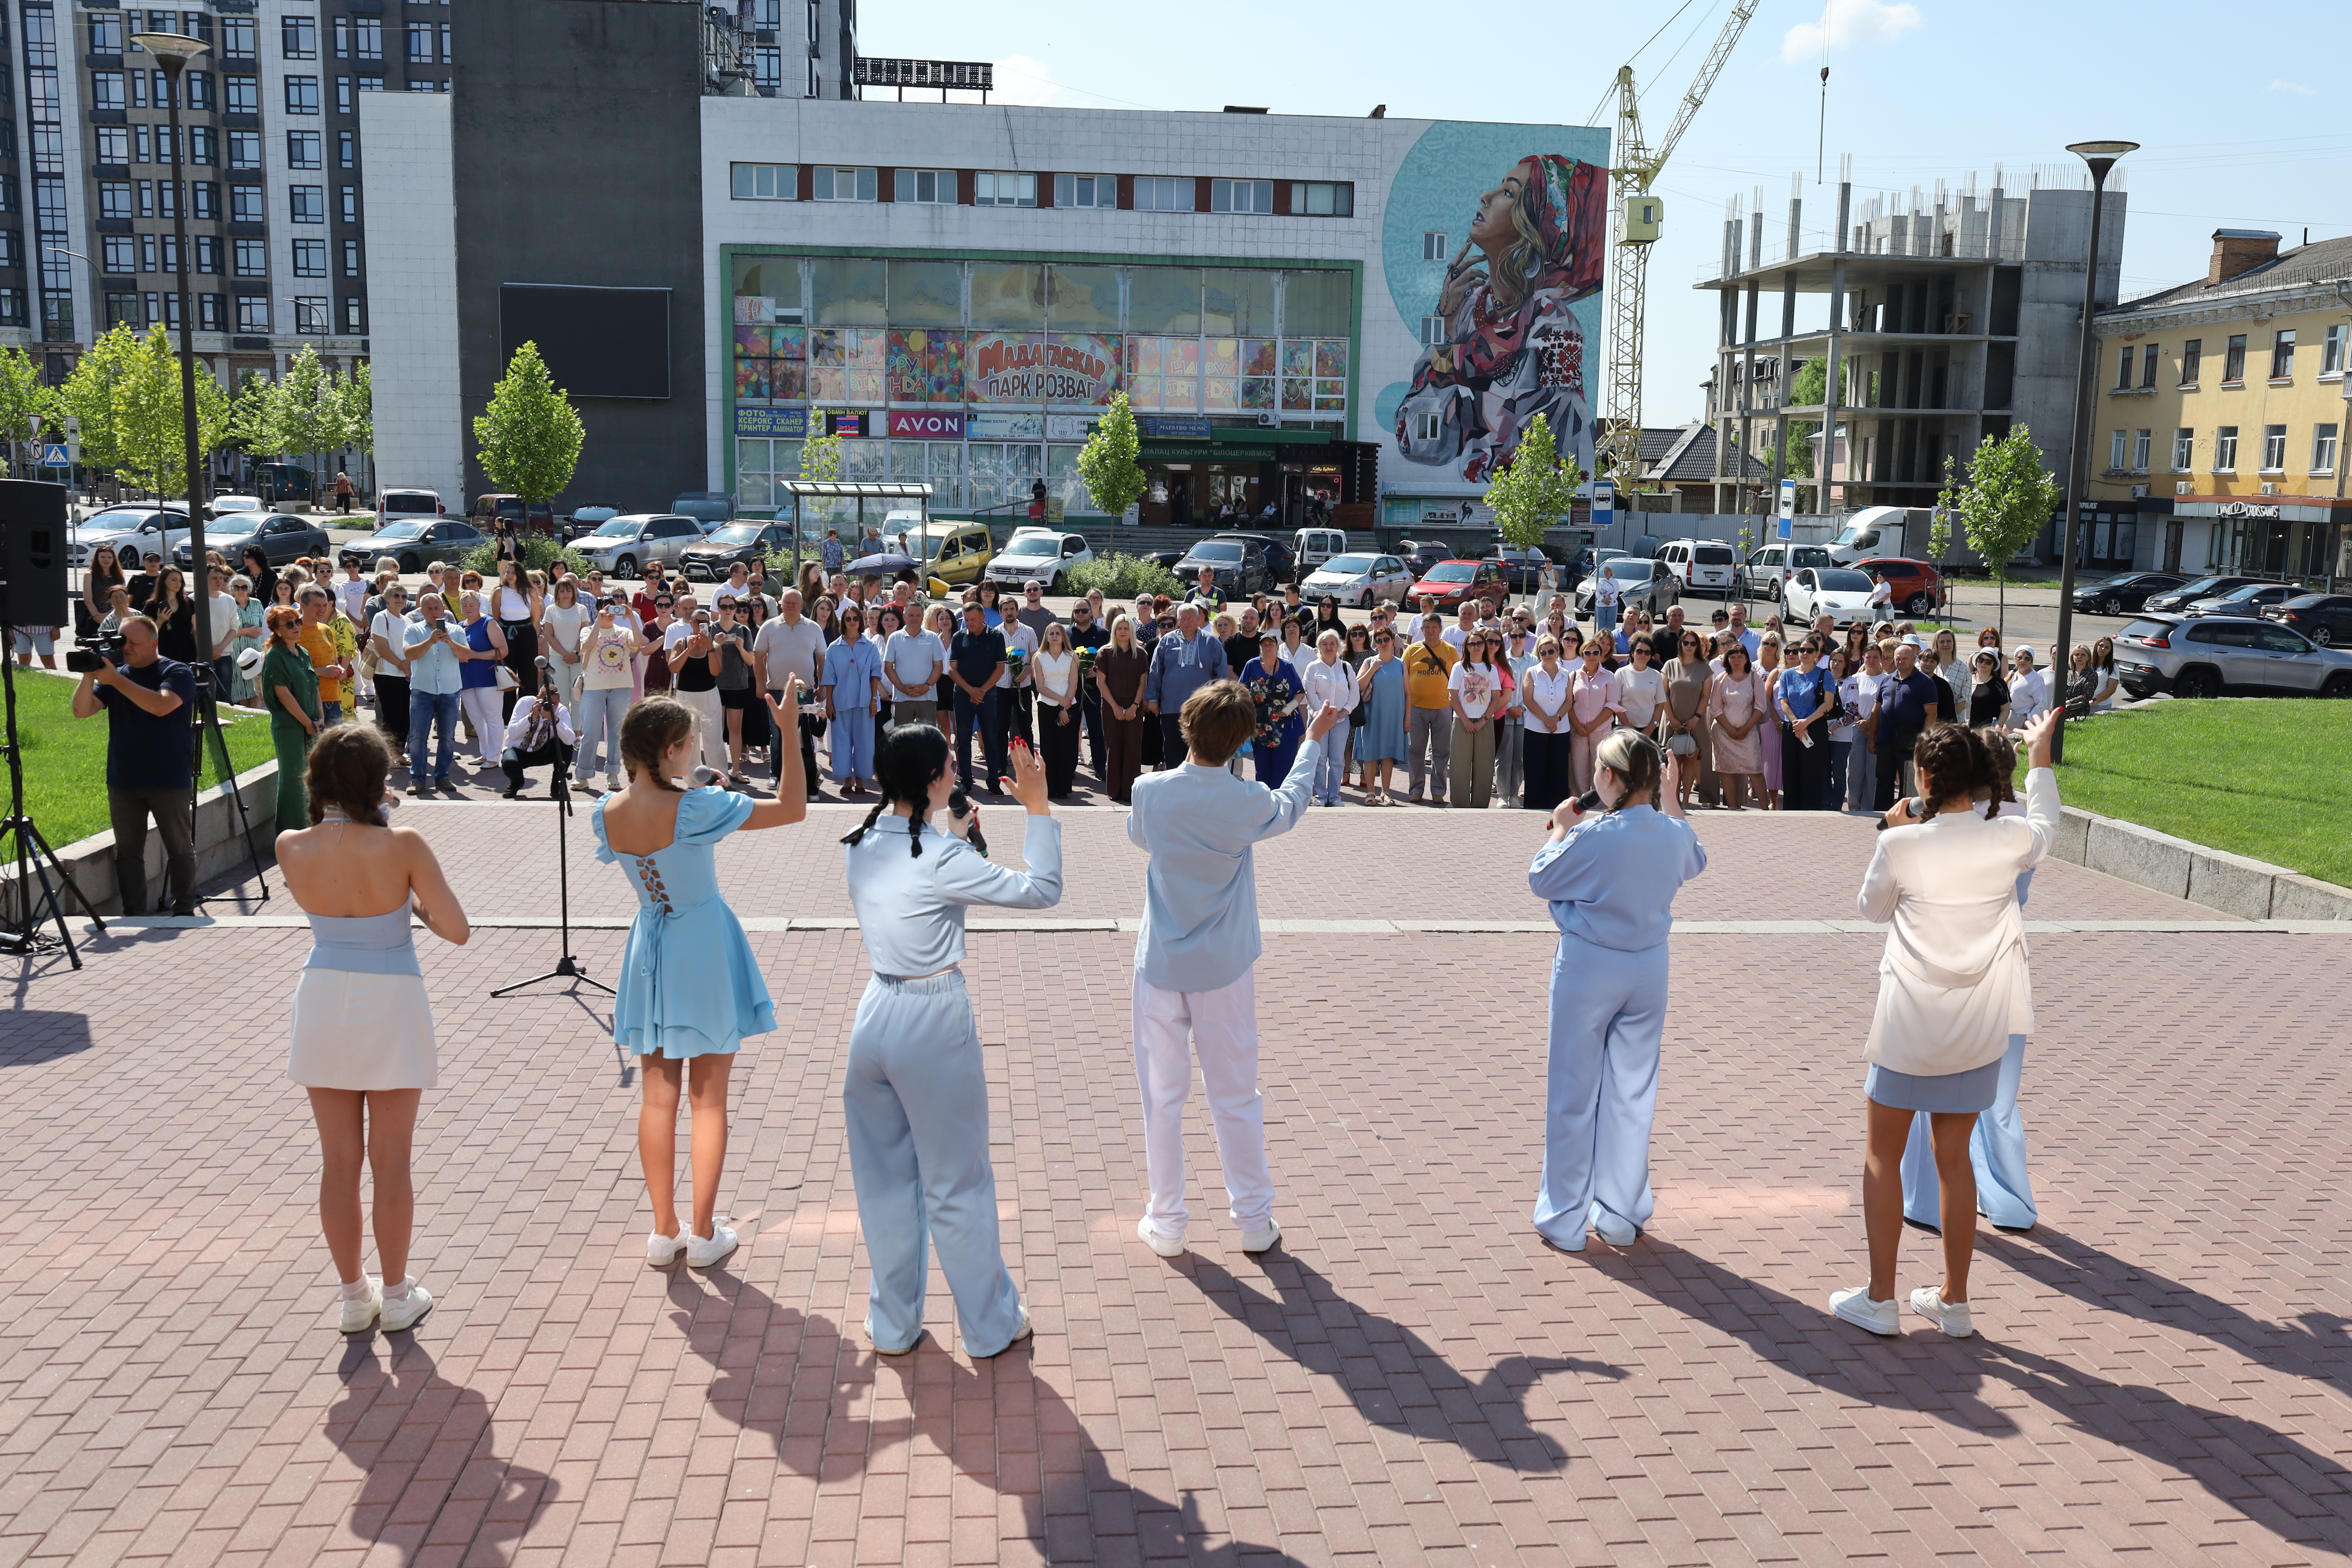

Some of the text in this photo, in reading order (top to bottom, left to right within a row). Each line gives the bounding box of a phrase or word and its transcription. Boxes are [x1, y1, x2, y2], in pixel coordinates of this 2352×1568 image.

[1171, 361, 1227, 378] HAPY
[988, 372, 1096, 400] ПАРК РОЗВАГ
[896, 417, 958, 432] AVON
